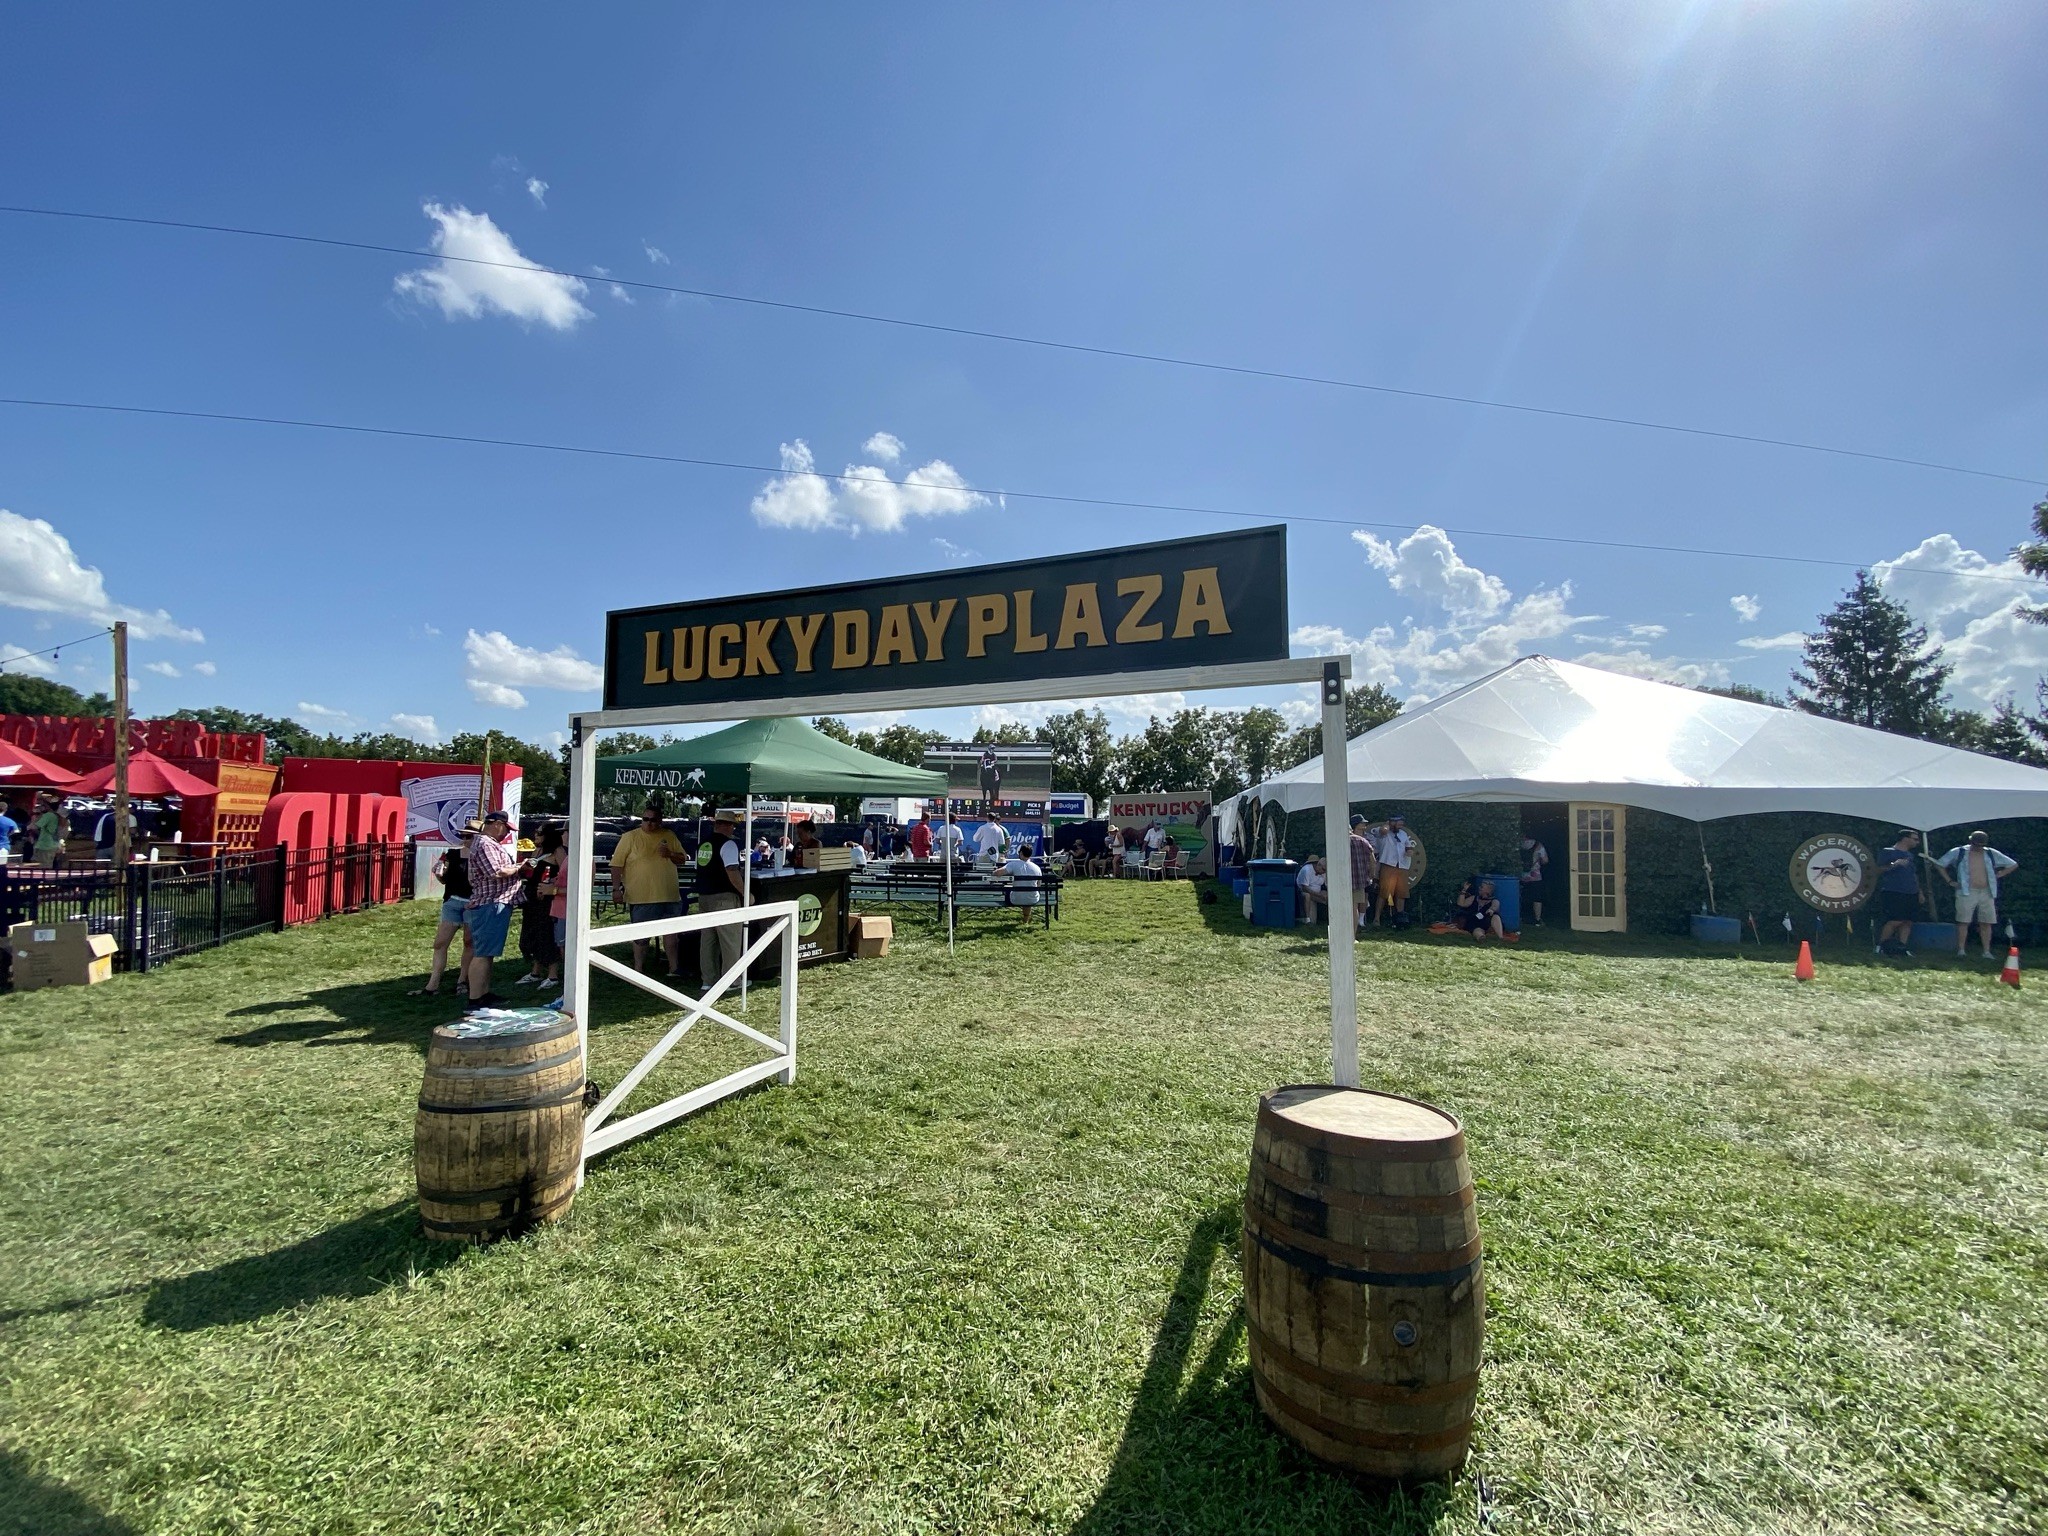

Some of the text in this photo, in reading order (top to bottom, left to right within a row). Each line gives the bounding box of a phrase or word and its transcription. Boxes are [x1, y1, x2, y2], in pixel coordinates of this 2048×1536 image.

[615, 768, 682, 788] KEENELAND
[1058, 802, 1080, 810] Budget
[1113, 800, 1205, 817] KENTUCKY
[1009, 831, 1040, 843] ober
[1798, 838, 1868, 861] WAGERING
[1802, 888, 1867, 909] CENTRAL
